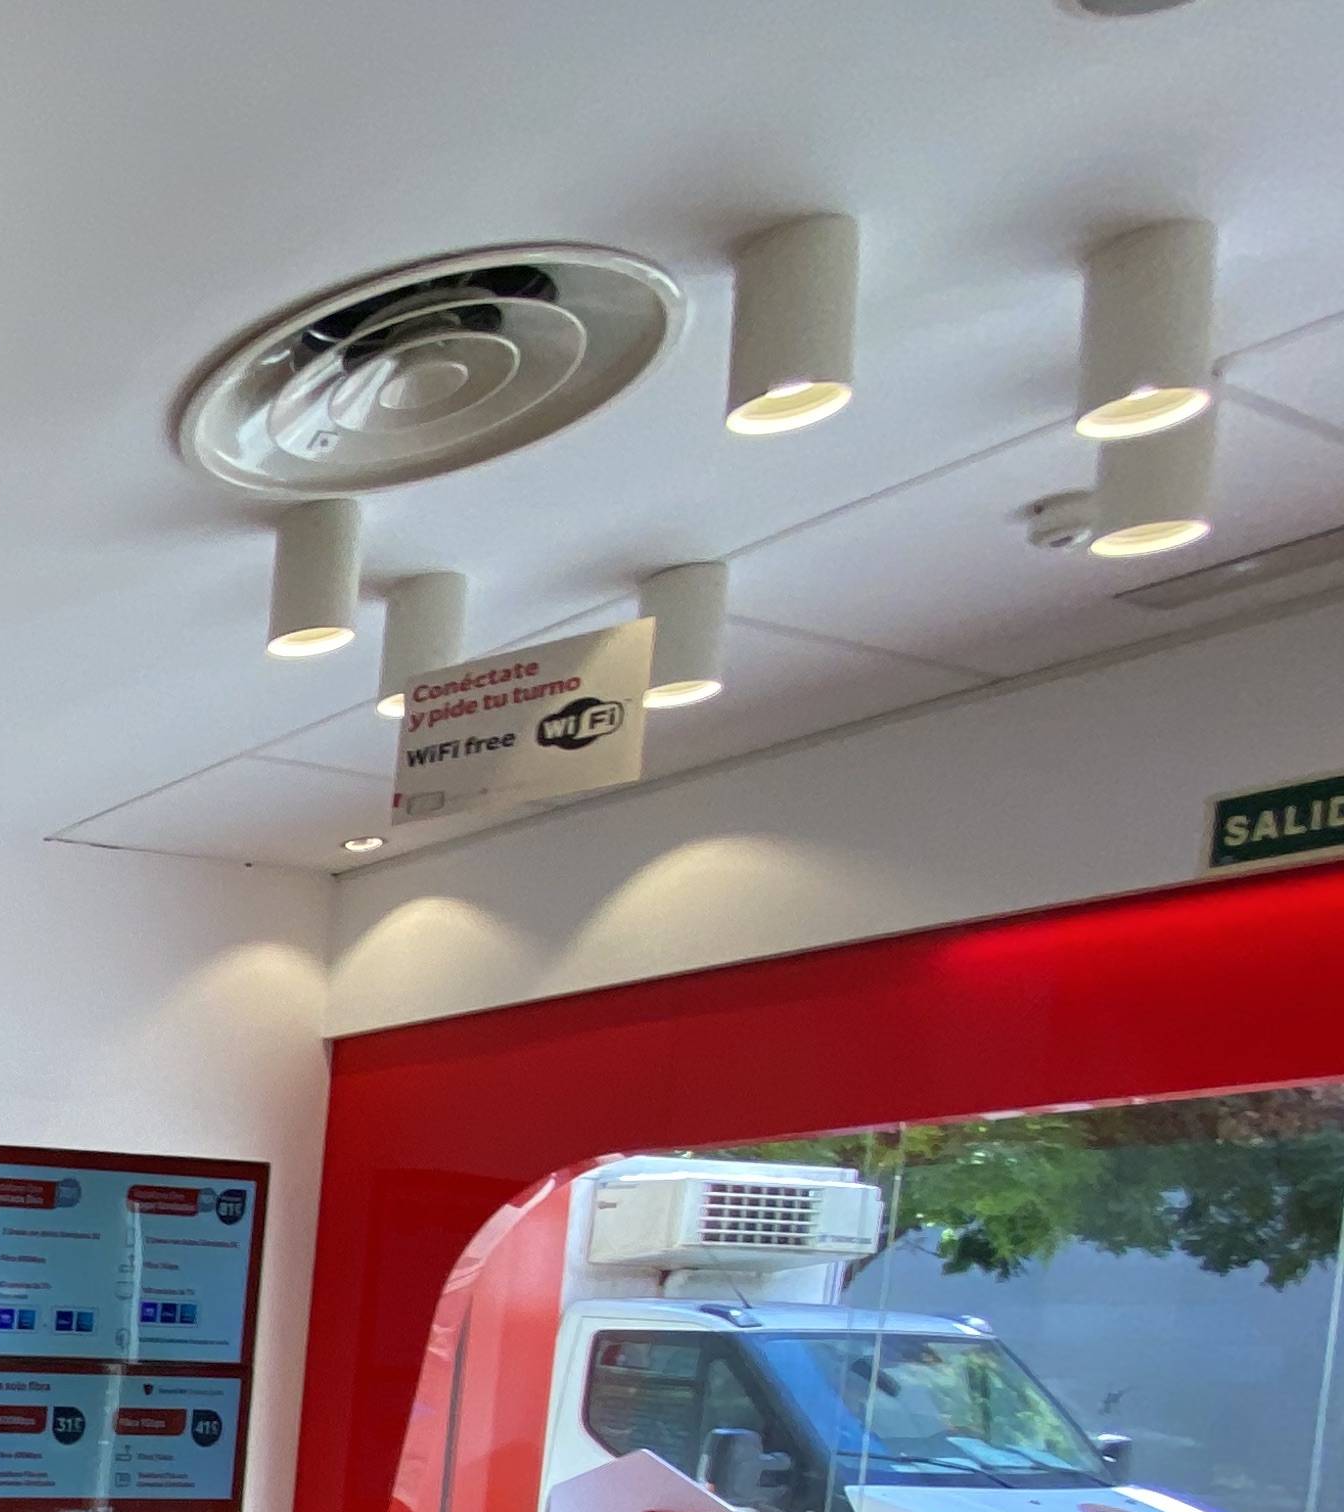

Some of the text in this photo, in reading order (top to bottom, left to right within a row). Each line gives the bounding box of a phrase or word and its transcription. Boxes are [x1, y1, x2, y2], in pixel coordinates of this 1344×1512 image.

[413, 661, 539, 702] Conéctate
[408, 676, 581, 732] y pide tu turno
[463, 733, 516, 756] free
